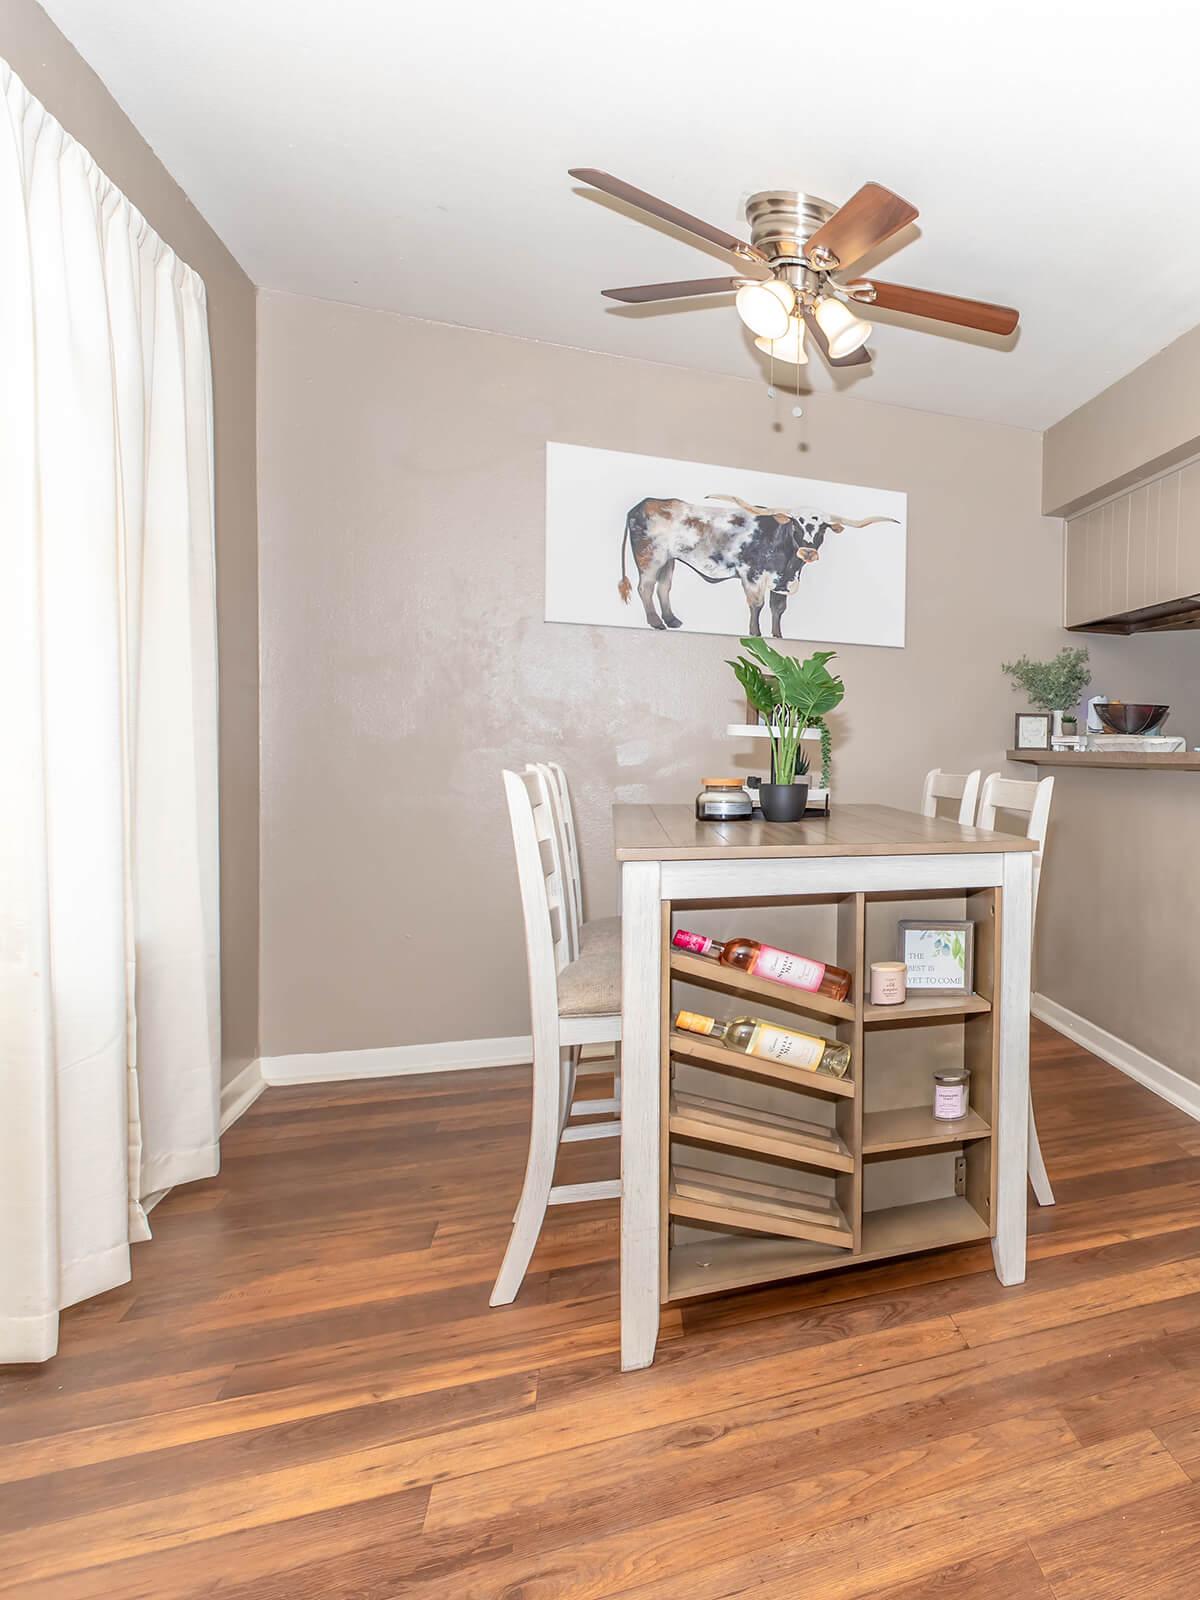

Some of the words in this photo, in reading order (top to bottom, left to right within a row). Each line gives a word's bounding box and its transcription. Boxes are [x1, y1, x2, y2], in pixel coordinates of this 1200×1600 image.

[908, 977, 923, 985] YET
[926, 977, 937, 985] TO
[938, 977, 963, 985] COME
